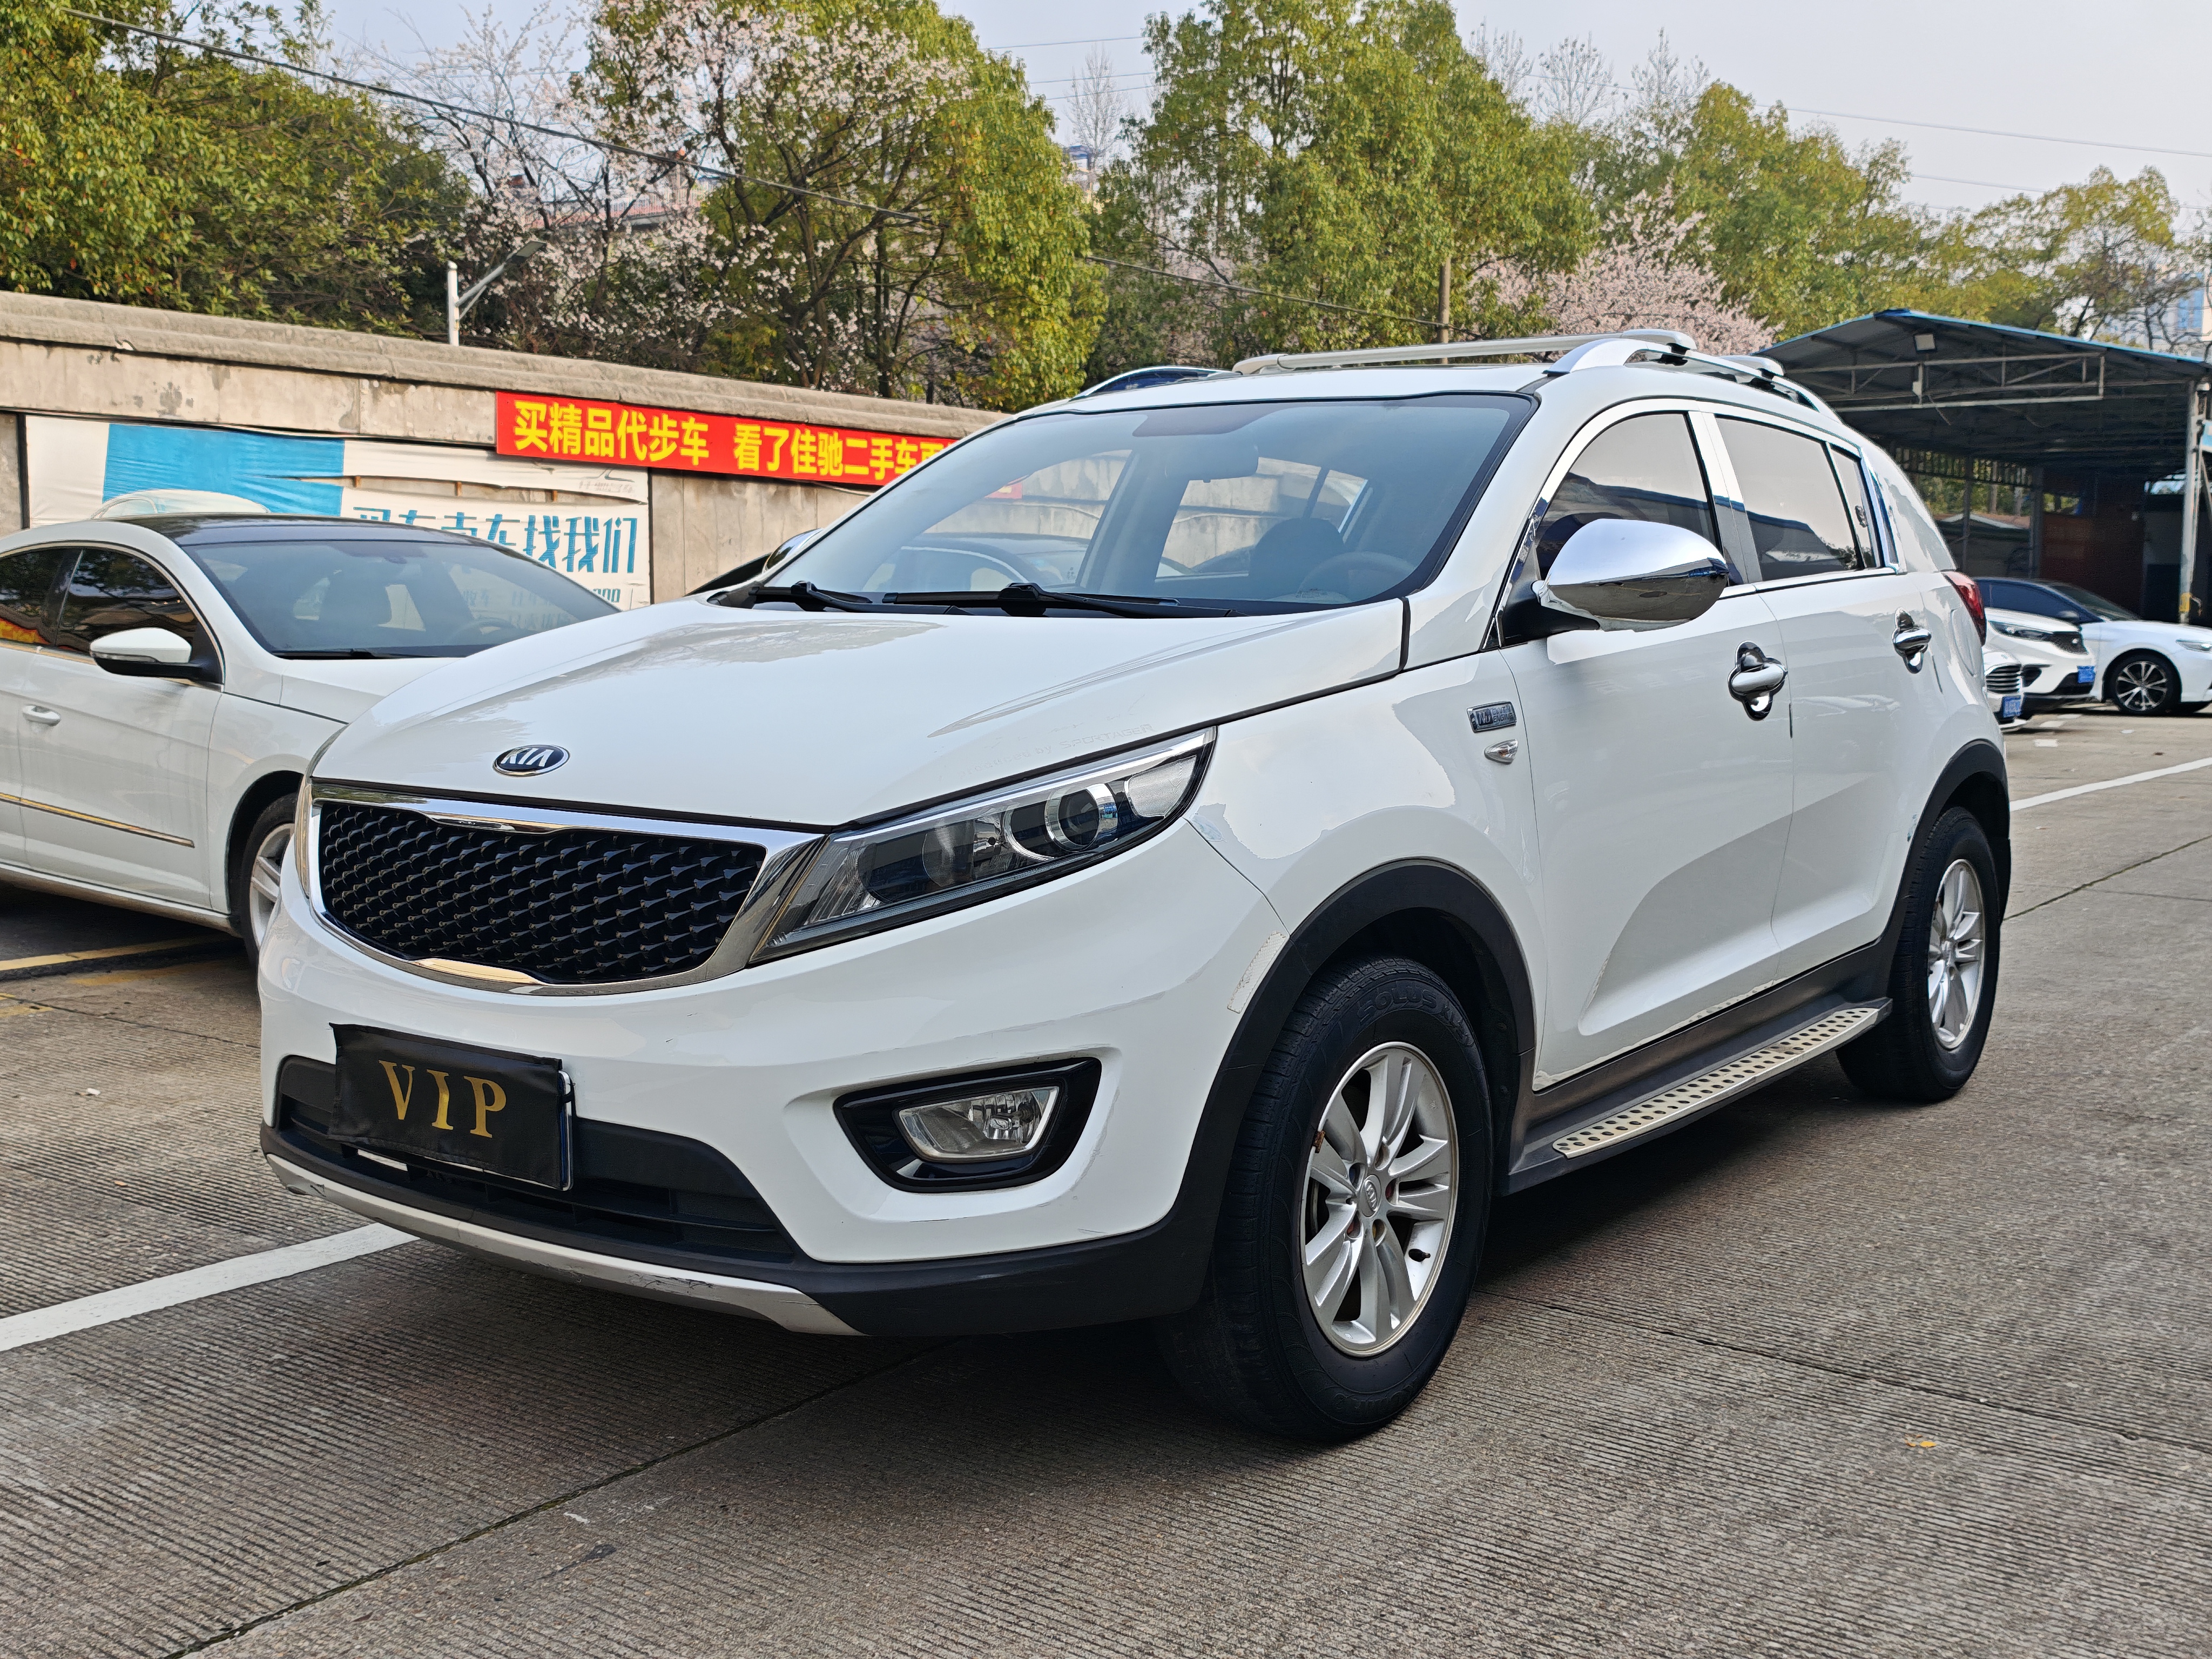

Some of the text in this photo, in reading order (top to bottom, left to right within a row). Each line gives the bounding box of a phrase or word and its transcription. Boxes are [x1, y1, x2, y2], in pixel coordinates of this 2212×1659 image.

[514, 400, 953, 481] 买精品代步车 看了佳驰二手车
[500, 747, 555, 767] KIA
[378, 1059, 508, 1138] VIP
